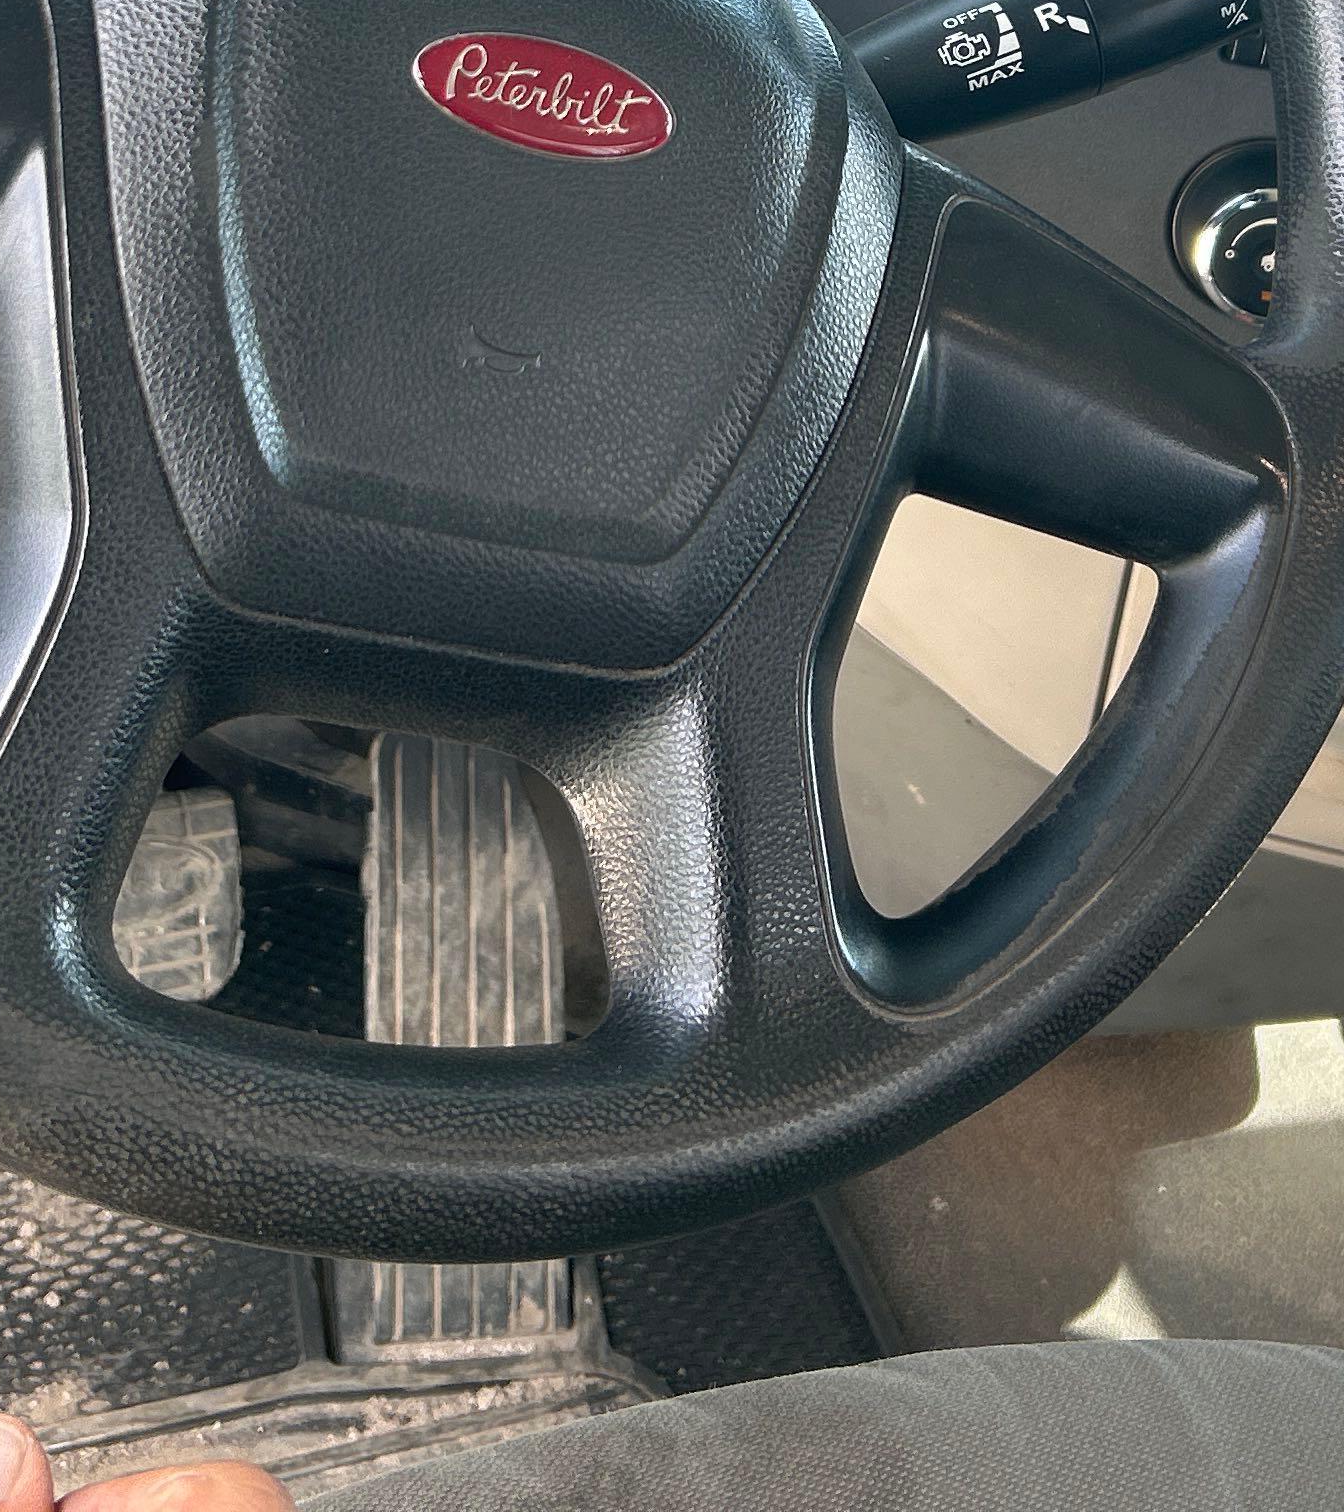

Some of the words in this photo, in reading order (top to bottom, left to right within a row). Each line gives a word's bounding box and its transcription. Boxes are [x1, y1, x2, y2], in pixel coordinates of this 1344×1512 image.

[942, 7, 981, 30] OFF
[1033, 1, 1066, 33] R
[445, 43, 652, 136] Peterbilt
[968, 62, 1026, 92] MAX
